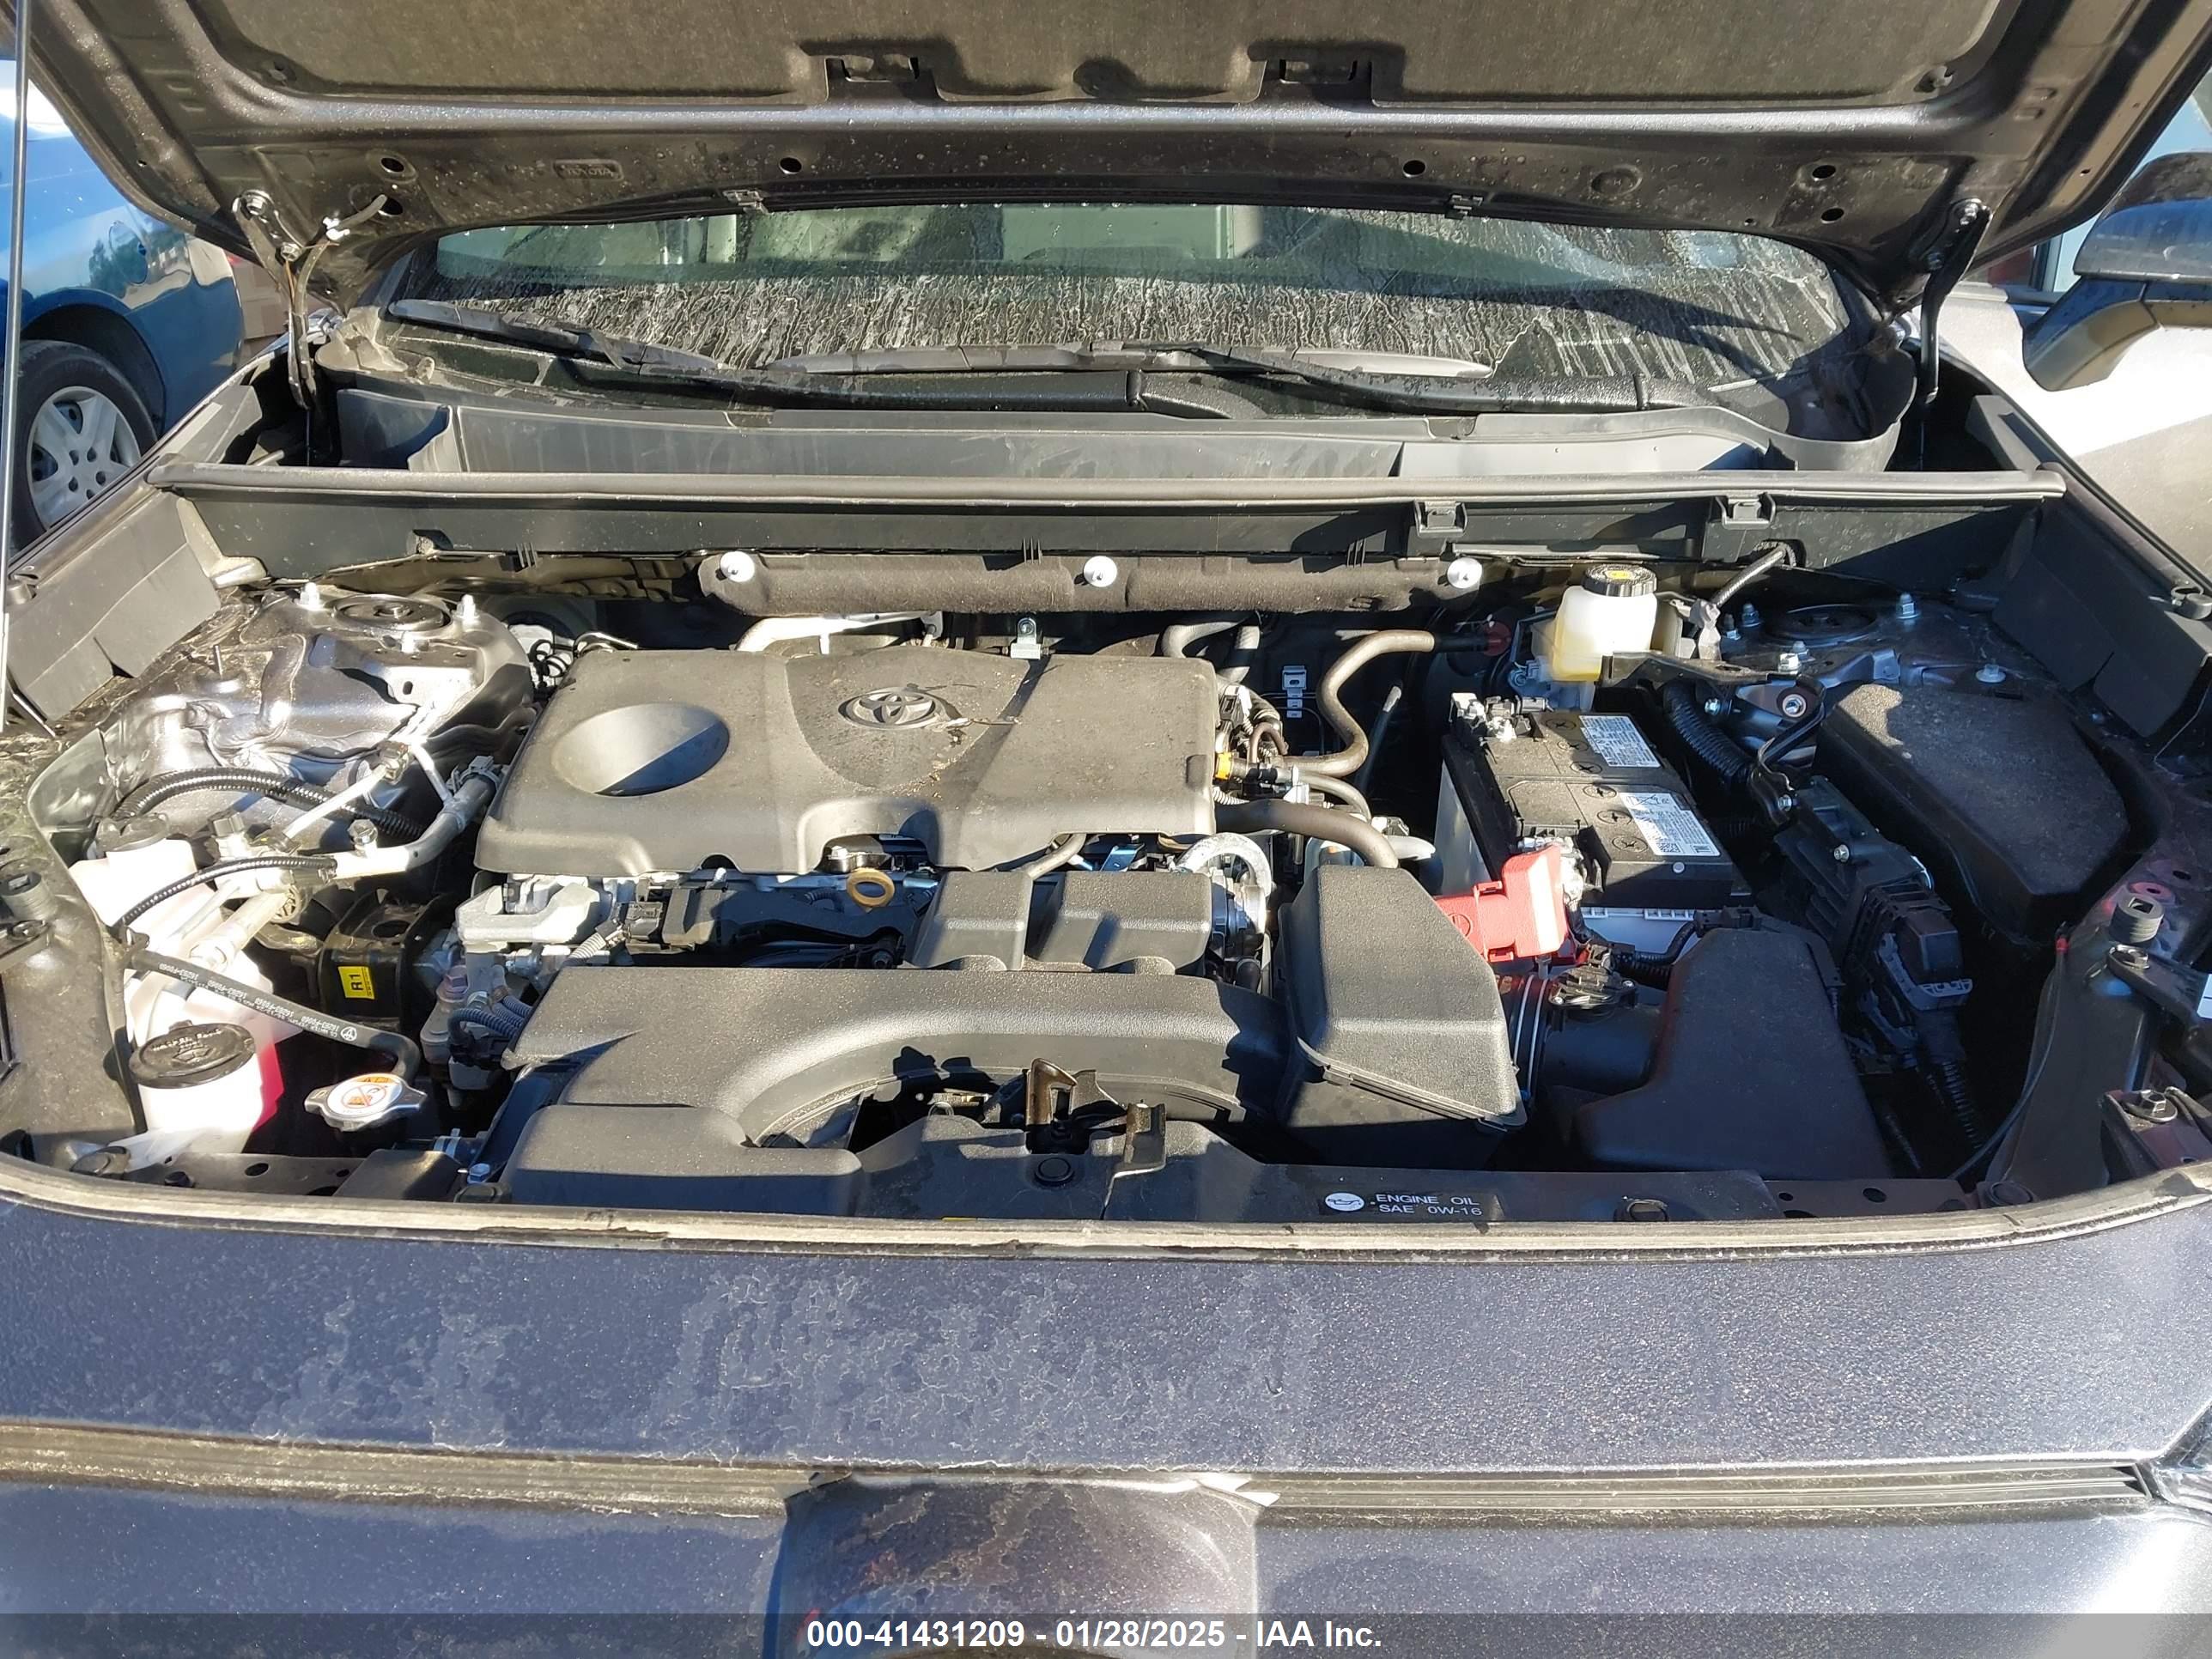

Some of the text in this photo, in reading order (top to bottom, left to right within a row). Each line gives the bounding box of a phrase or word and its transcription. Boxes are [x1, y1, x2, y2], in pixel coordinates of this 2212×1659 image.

[348, 974, 364, 991] R1
[1376, 1194, 1480, 1206] ENGINE OIL
[1379, 1204, 1483, 1217] SAE 0W-16
